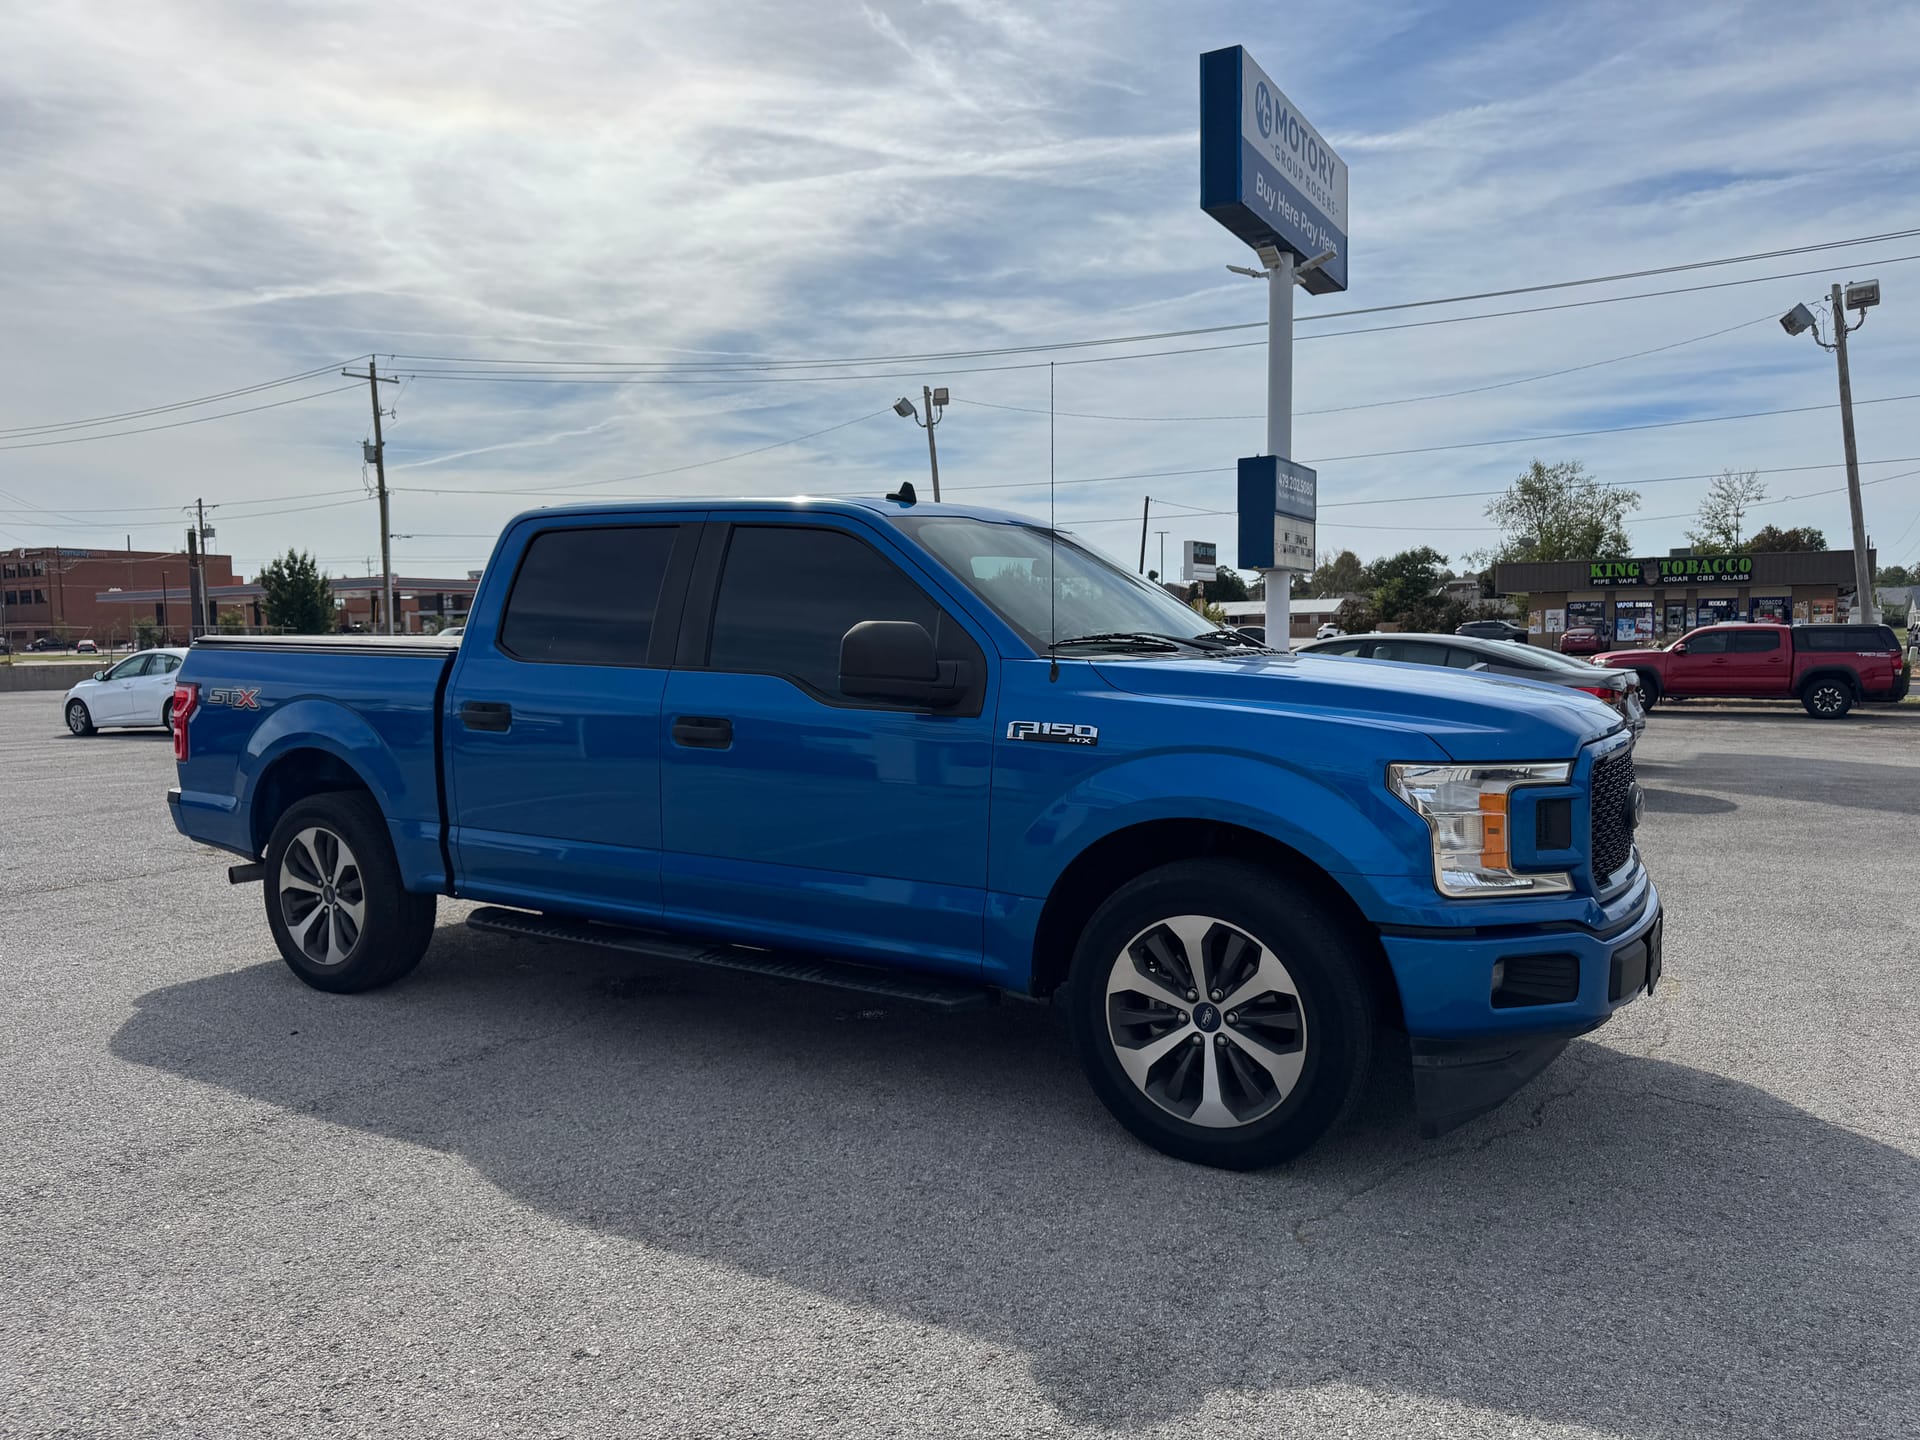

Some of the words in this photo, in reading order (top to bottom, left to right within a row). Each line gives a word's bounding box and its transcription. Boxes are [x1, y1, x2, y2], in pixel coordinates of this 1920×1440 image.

[1275, 98, 1335, 190] MOTORY
[1256, 171, 1276, 211] Buy
[1278, 191, 1299, 228] Here
[1301, 211, 1318, 247] Pay
[1320, 227, 1337, 255] Here
[1590, 562, 1640, 578] KING
[1659, 558, 1752, 575] TOBACCO
[1663, 575, 1688, 583] CIGAR
[208, 687, 261, 711] STX
